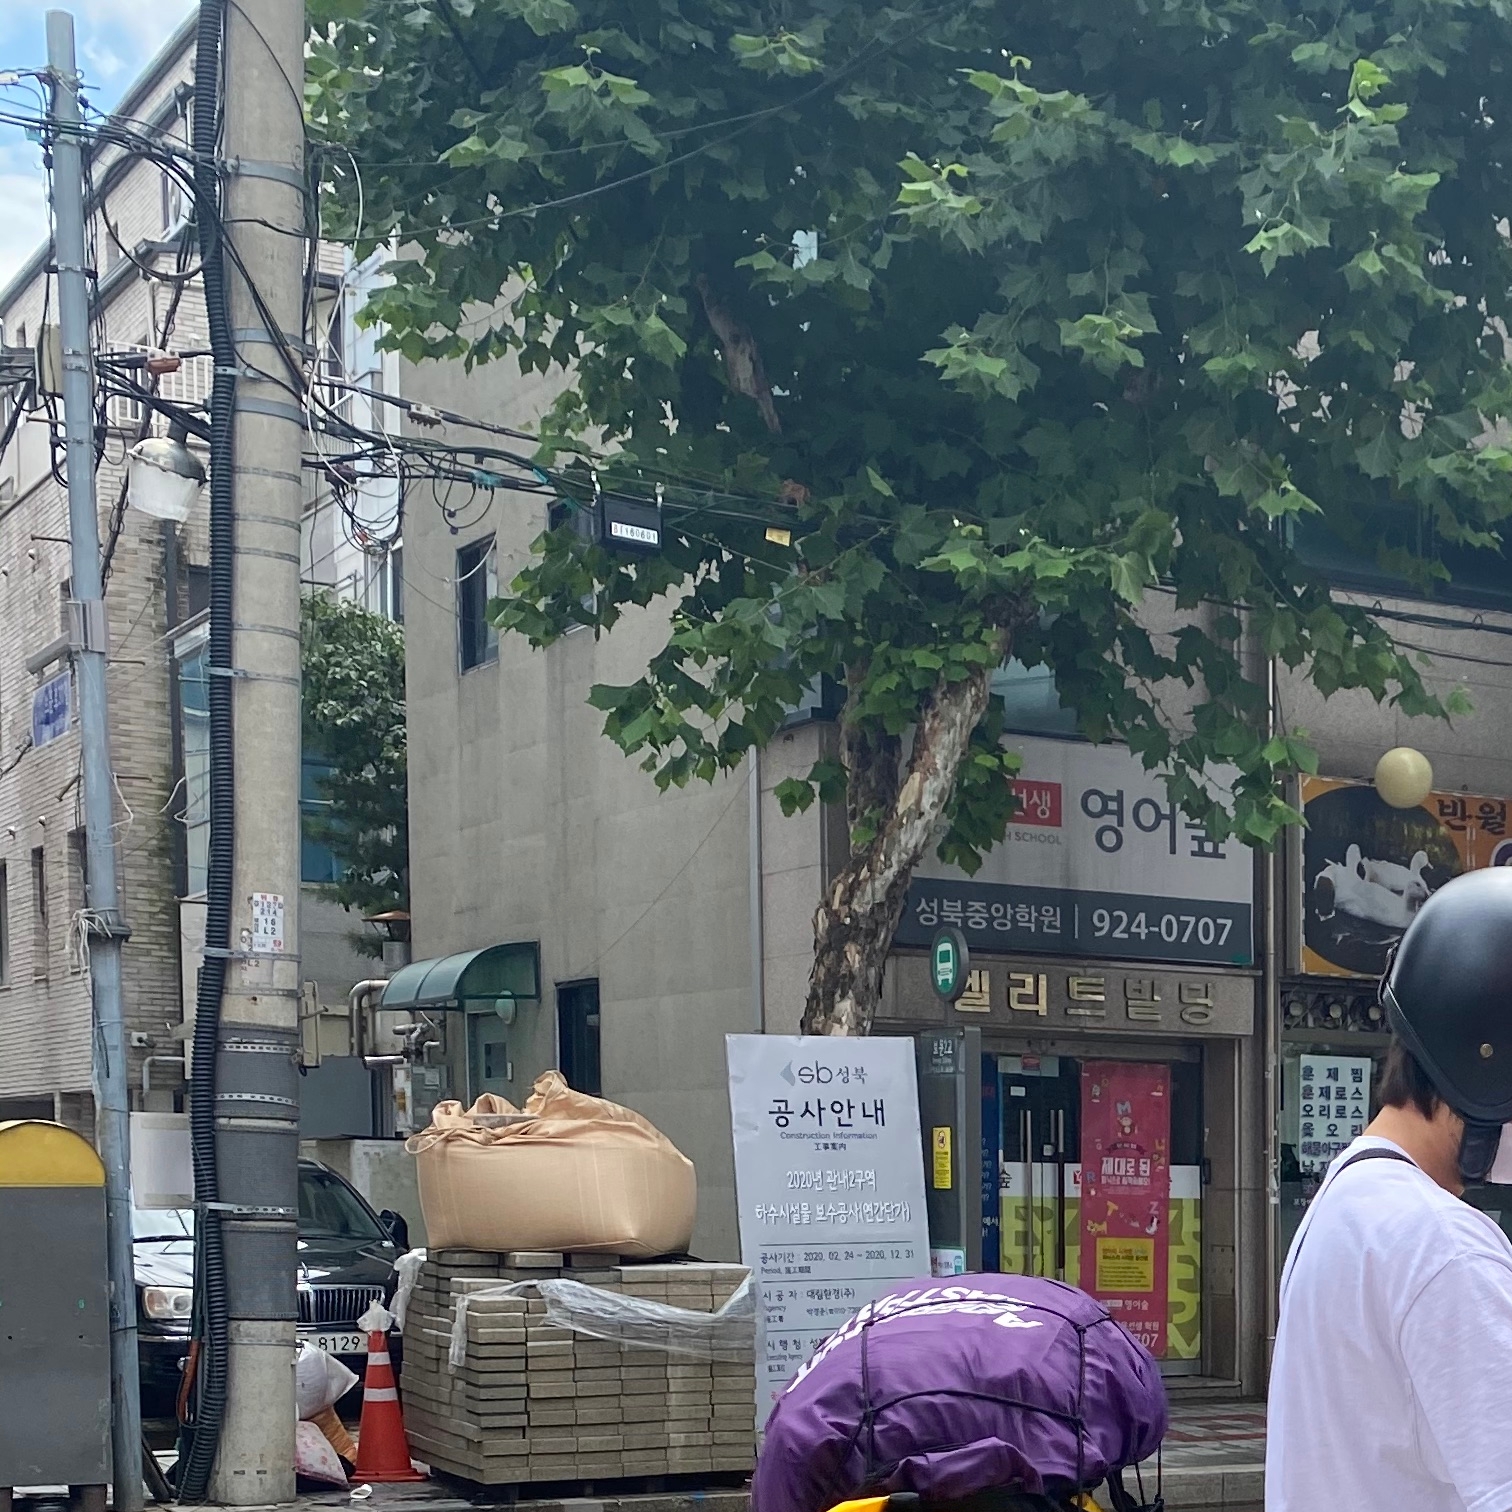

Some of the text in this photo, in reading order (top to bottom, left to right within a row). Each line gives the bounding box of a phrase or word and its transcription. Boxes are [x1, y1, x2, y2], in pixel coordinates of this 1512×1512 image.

[1436, 797, 1508, 836] 반월
[1015, 831, 1062, 846] SCHOOL
[915, 897, 1234, 947] 성북중앙학원 924-0707
[798, 1060, 869, 1085] sb 성북
[768, 1098, 886, 1128] 공사안내
[1301, 1103, 1364, 1120] 오리로스
[780, 1131, 878, 1140] Construction Information
[786, 1169, 878, 1193] 2020년 관내2구역
[760, 1252, 795, 1265] 공사기간
[318, 1335, 361, 1352] 8129
